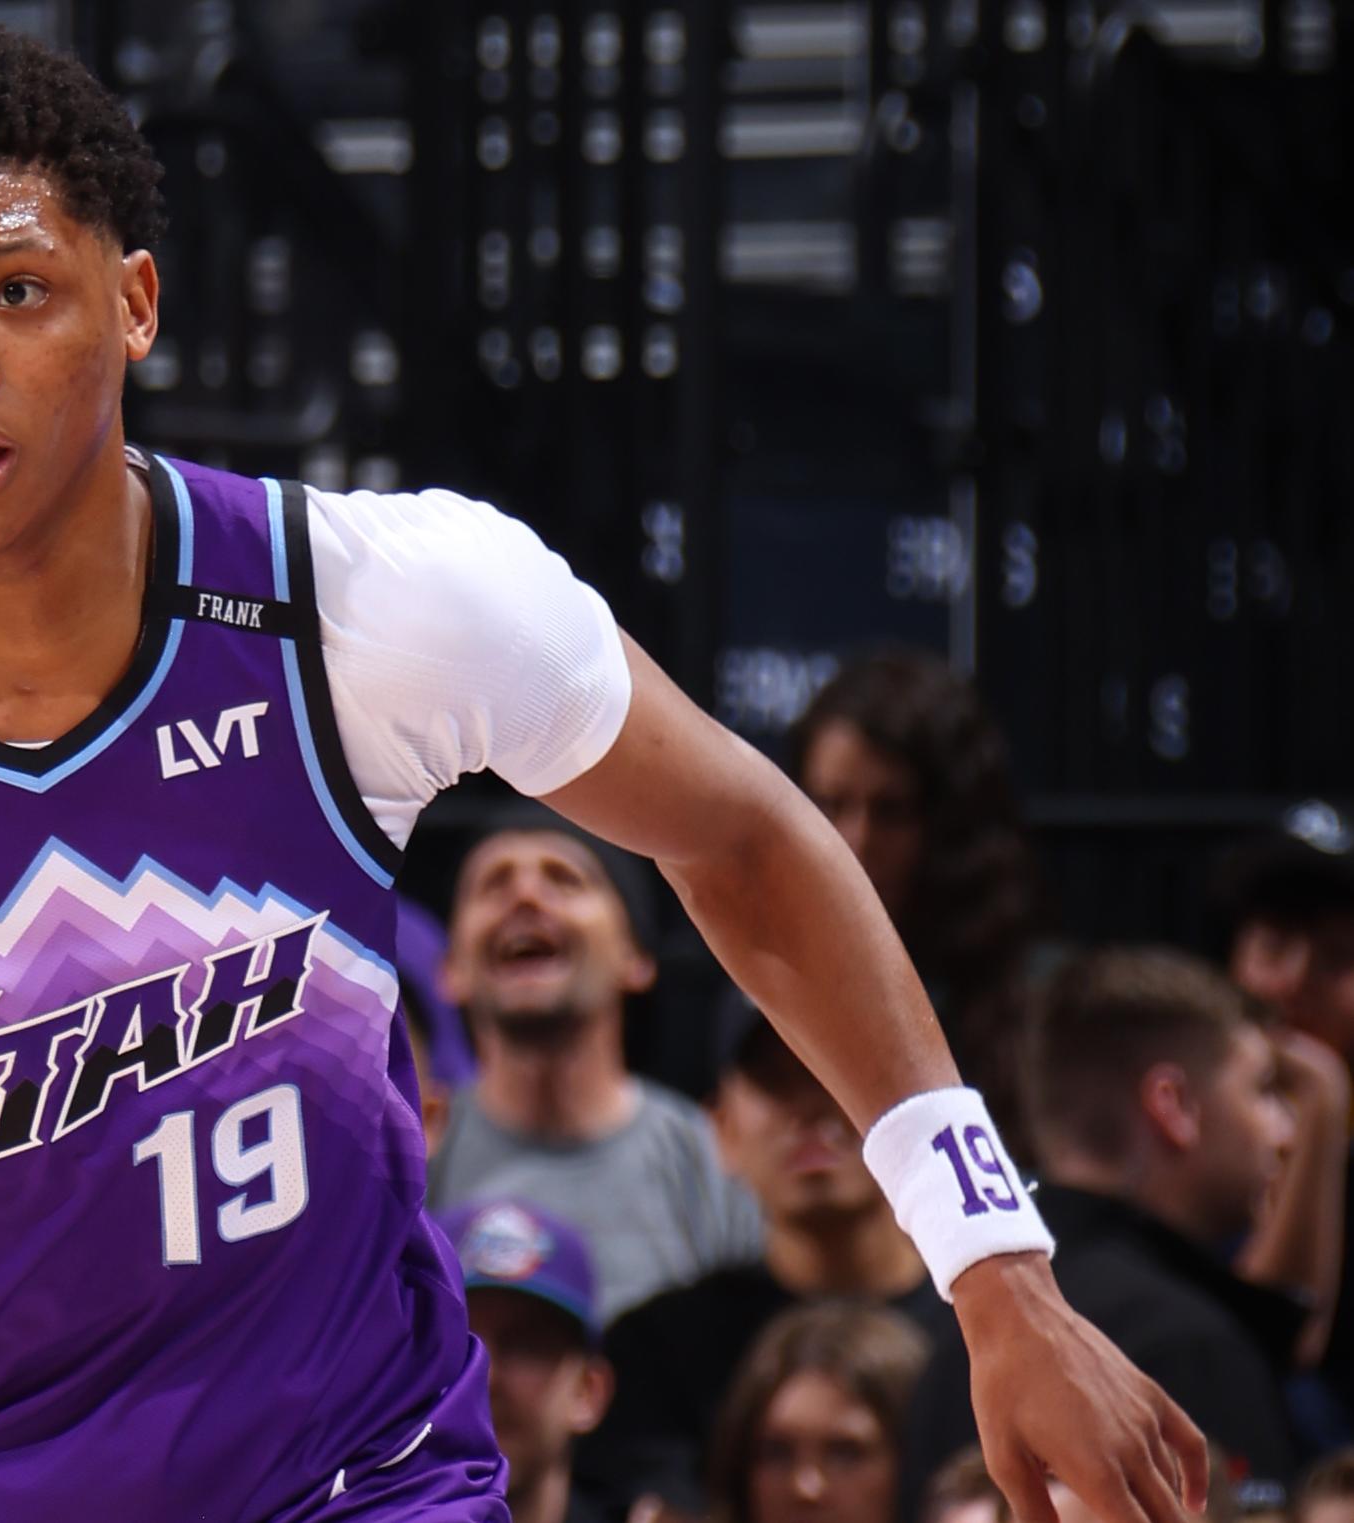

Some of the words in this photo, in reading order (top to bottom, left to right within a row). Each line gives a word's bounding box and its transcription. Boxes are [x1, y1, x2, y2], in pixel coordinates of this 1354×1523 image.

[197, 593, 264, 628] FRANK
[156, 702, 269, 779] LVT
[133, 1083, 309, 1266] 19
[932, 1124, 1019, 1217] 19
